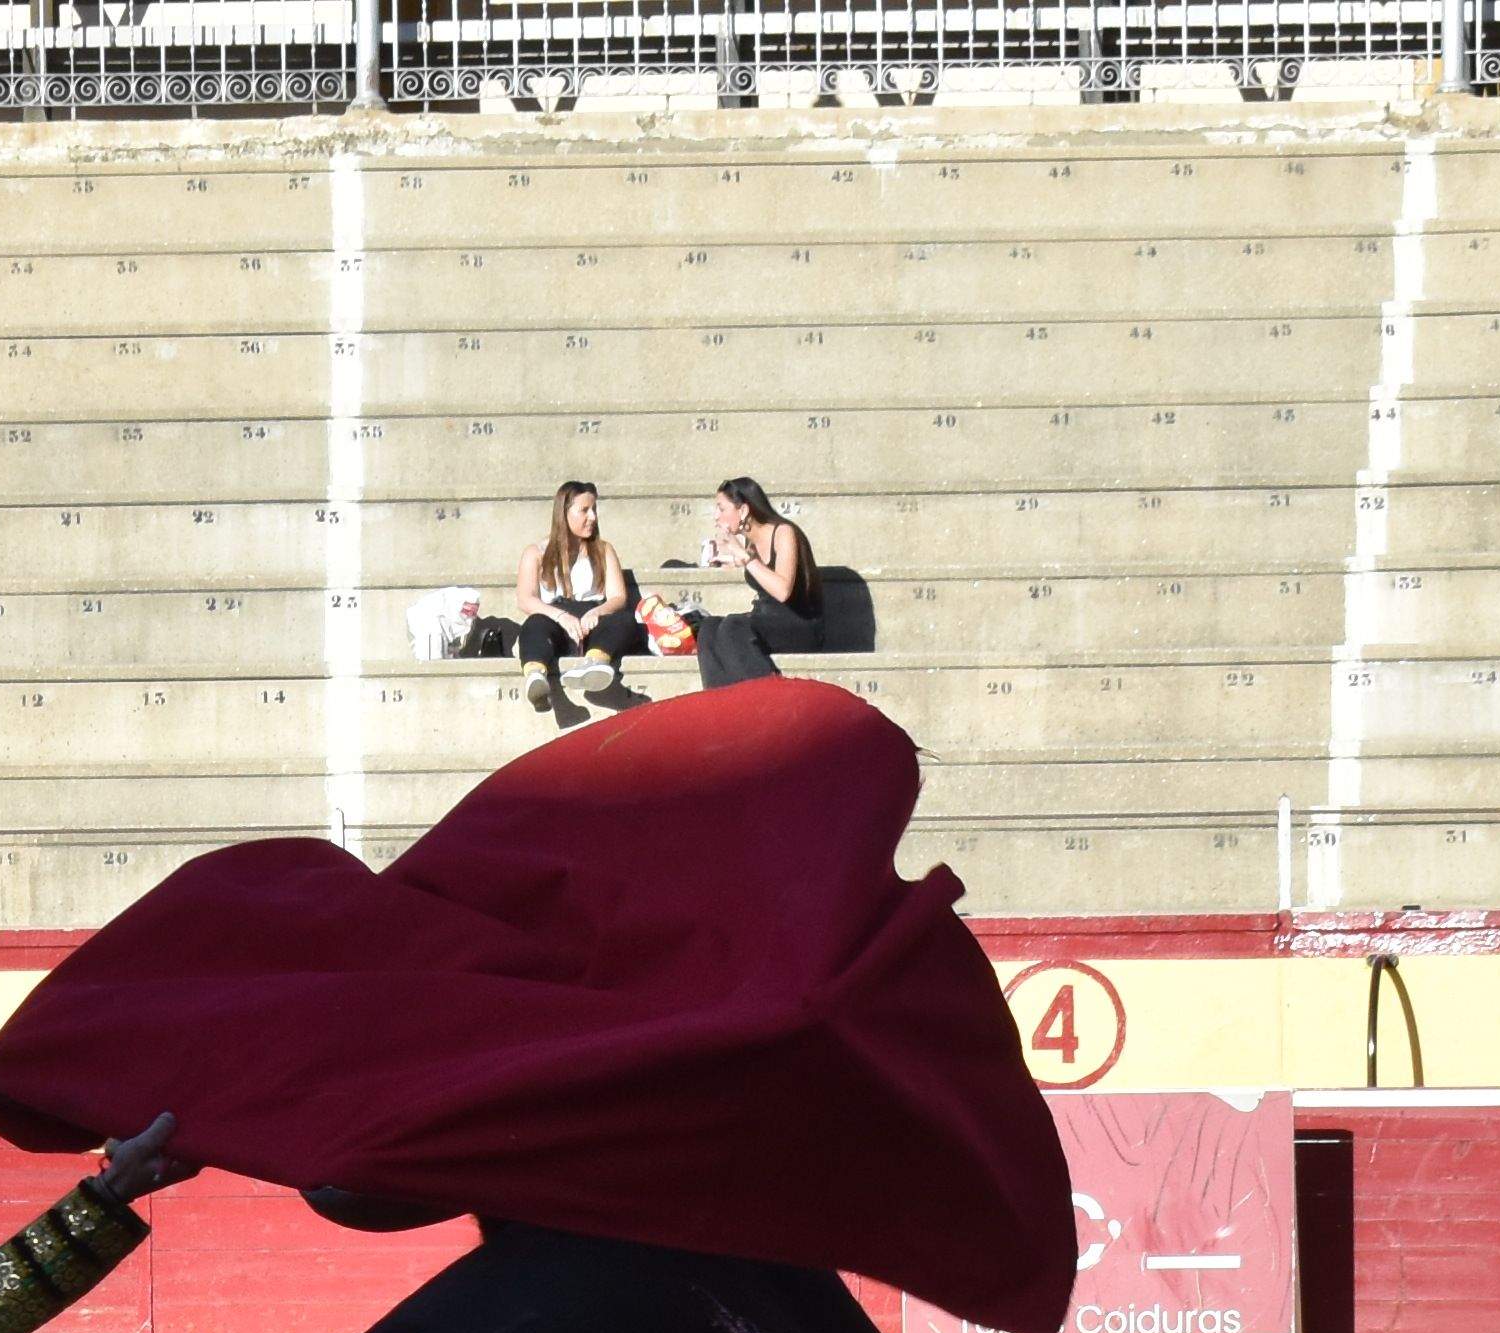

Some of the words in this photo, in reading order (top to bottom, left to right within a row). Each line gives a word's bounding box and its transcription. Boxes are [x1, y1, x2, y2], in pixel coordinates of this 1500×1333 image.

[722, 171, 740, 182] 41
[832, 170, 853, 182] 42
[1049, 166, 1071, 178] 44
[685, 252, 707, 264] 40
[791, 249, 809, 263] 41
[805, 331, 823, 344] 41
[1050, 413, 1069, 425] 41
[1152, 412, 1175, 424] 42
[1372, 408, 1395, 420] 44
[933, 415, 956, 427] 40
[1017, 498, 1038, 511] 29
[61, 513, 80, 527] 21
[193, 511, 213, 523] 22
[1029, 586, 1052, 599] 29
[83, 600, 101, 612] 21
[498, 688, 519, 700] 16
[987, 682, 1012, 694] 20
[22, 694, 43, 707] 12
[264, 691, 285, 703] 14
[104, 852, 127, 864] 20
[1032, 985, 1080, 1064] 4
